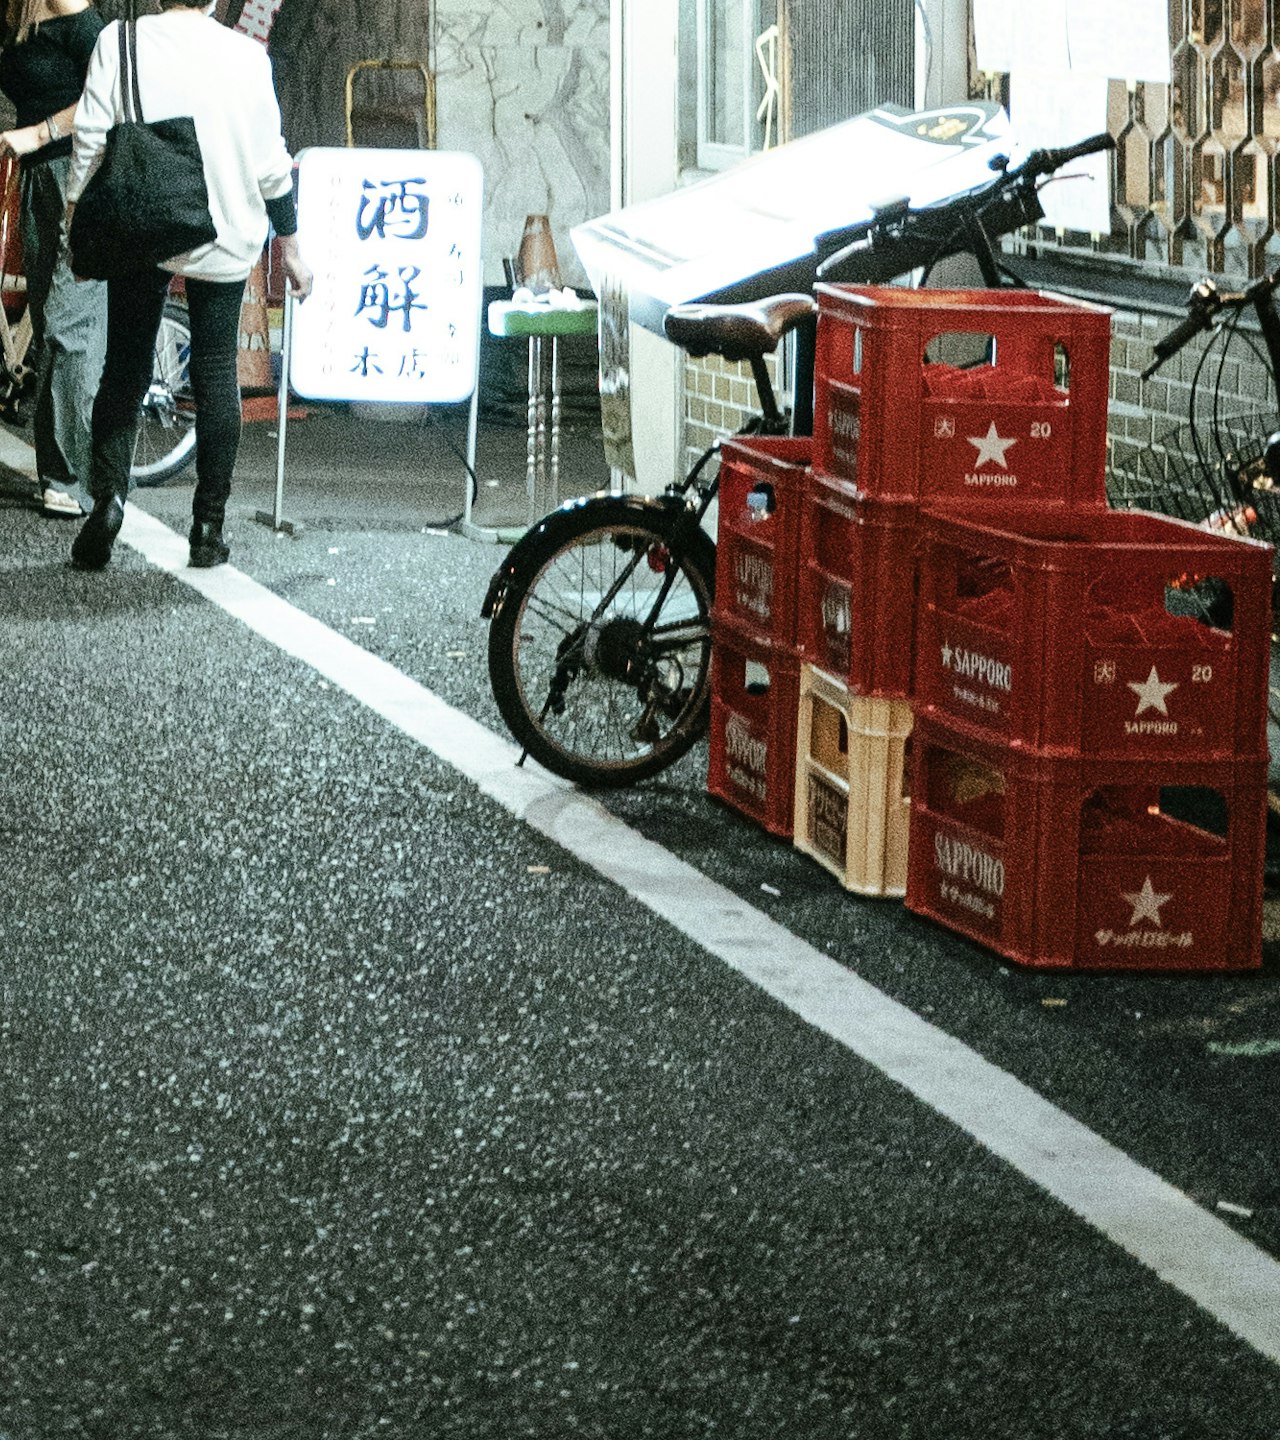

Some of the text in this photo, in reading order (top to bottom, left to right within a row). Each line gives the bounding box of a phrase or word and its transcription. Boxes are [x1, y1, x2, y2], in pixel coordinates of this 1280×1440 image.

[1029, 421, 1052, 439] 20
[963, 473, 1017, 487] SAPPORO
[953, 646, 1012, 693] SAPPORO
[1191, 664, 1213, 683] 20
[1123, 720, 1178, 736] SAPPORO
[934, 830, 1005, 898] SAPPORO
